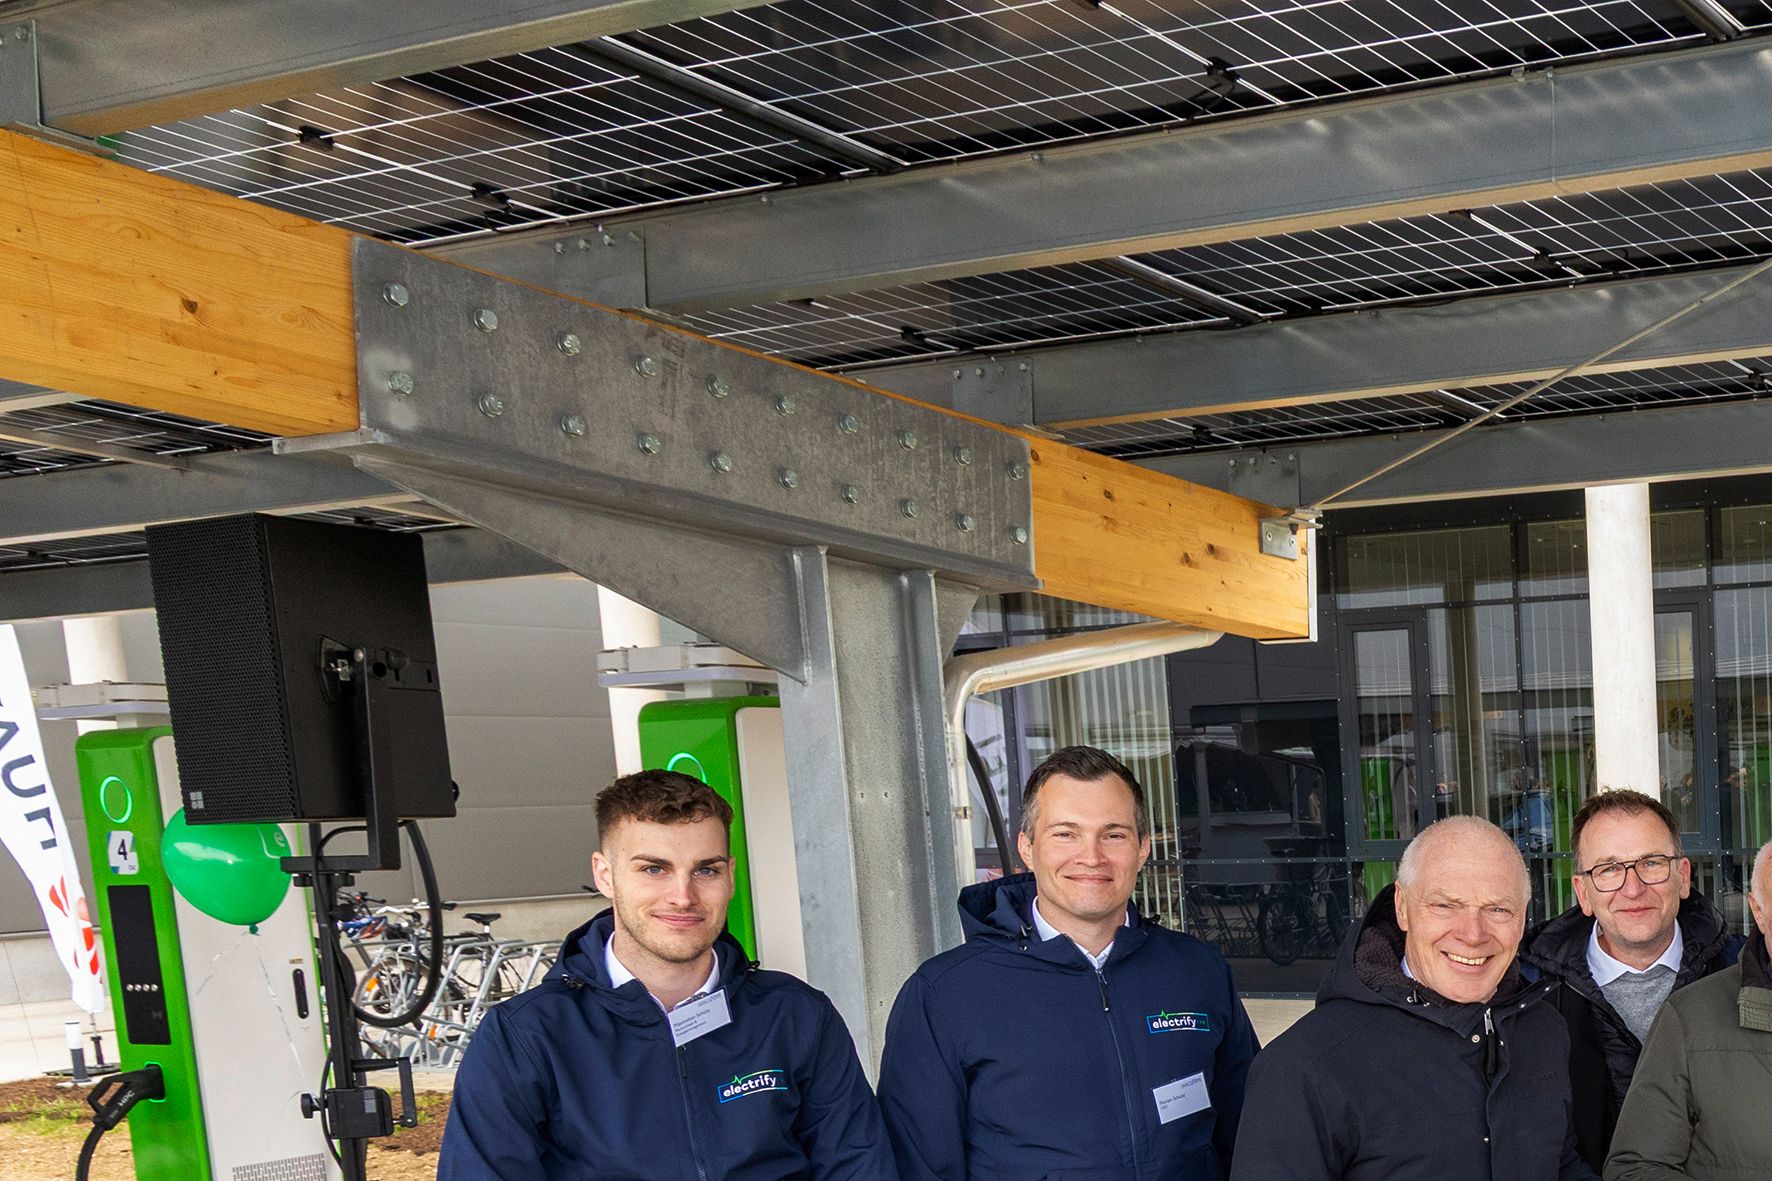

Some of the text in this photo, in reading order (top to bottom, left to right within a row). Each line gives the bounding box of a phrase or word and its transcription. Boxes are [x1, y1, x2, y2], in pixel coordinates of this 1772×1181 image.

[117, 838, 128, 861] 4
[1152, 1015, 1196, 1029] electrify
[723, 1074, 777, 1097] electrify
[117, 1090, 136, 1107] HPC
